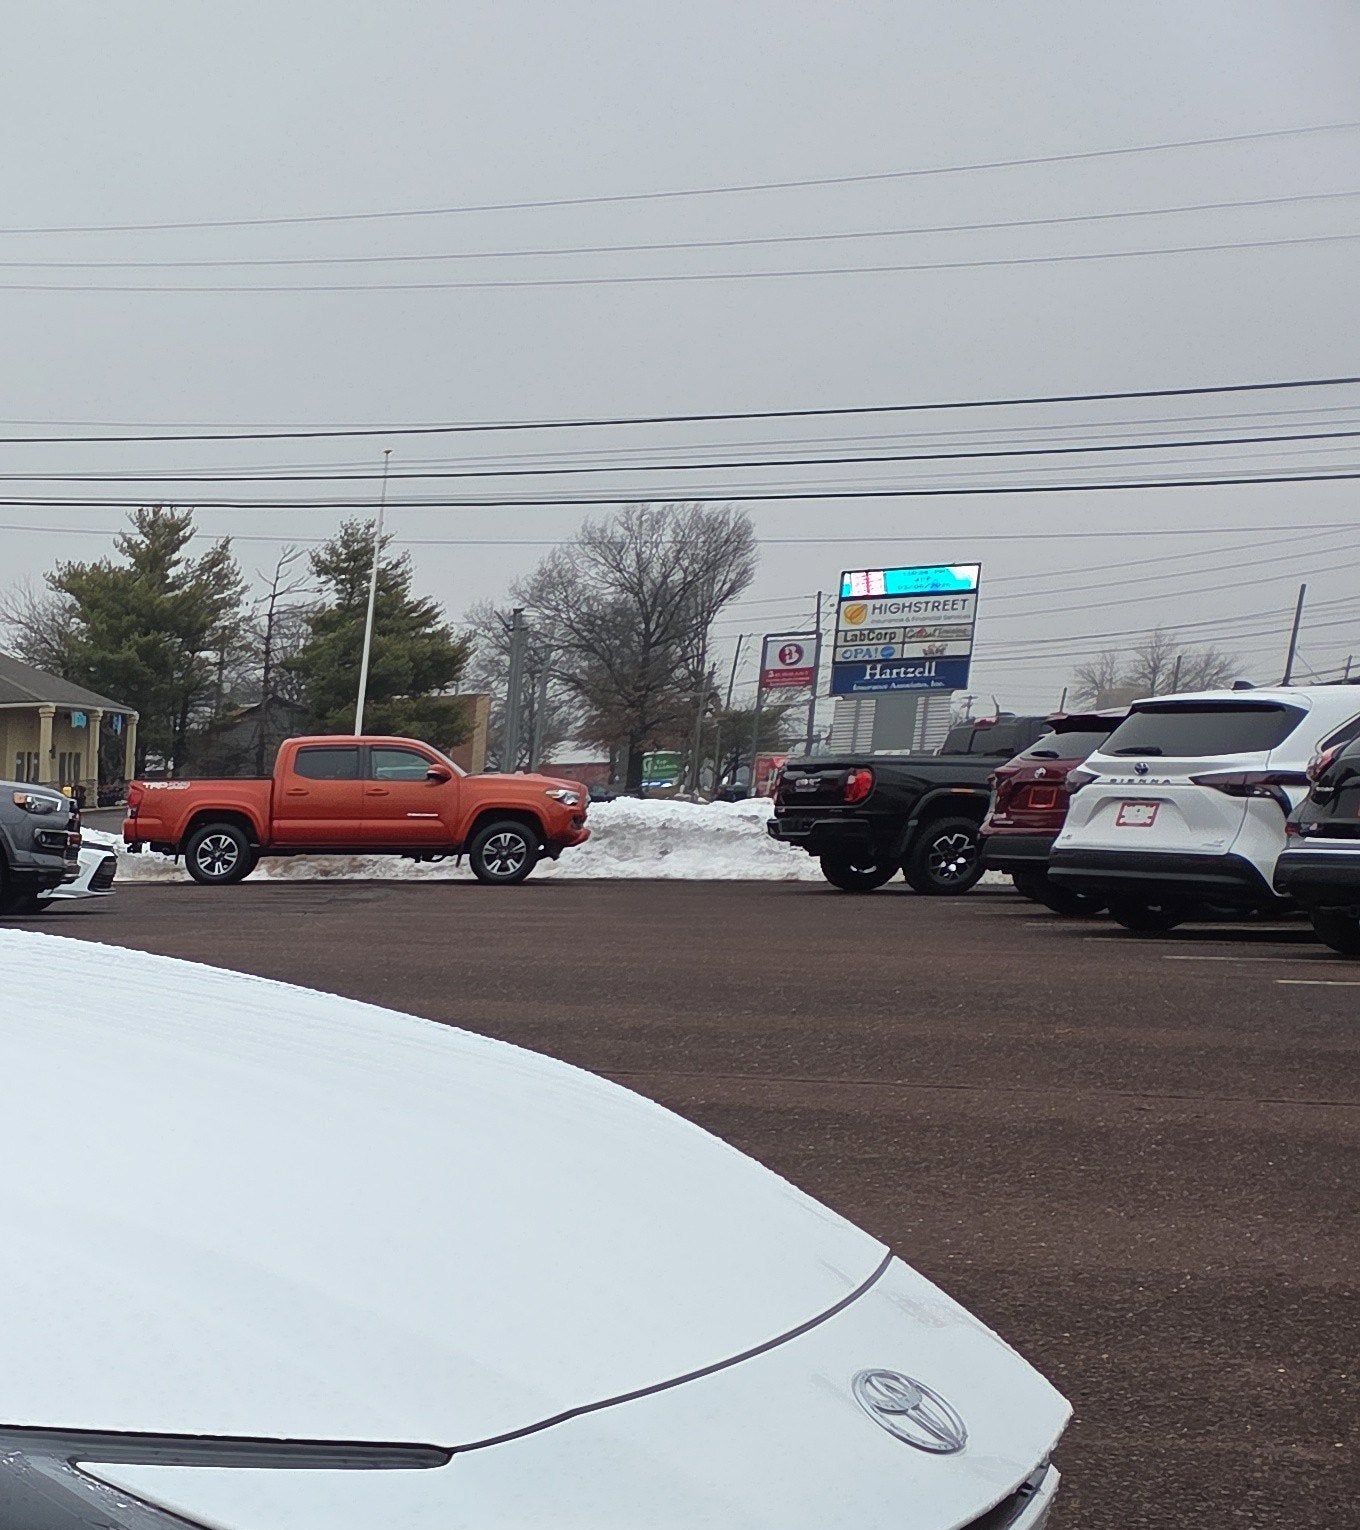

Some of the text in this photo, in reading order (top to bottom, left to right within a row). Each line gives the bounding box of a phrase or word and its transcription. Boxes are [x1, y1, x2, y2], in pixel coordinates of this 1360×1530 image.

[871, 598, 970, 616] HIGHSTREET
[844, 630, 896, 643] LabCorp
[842, 646, 878, 659] OPA!
[864, 661, 936, 680] Hartzell
